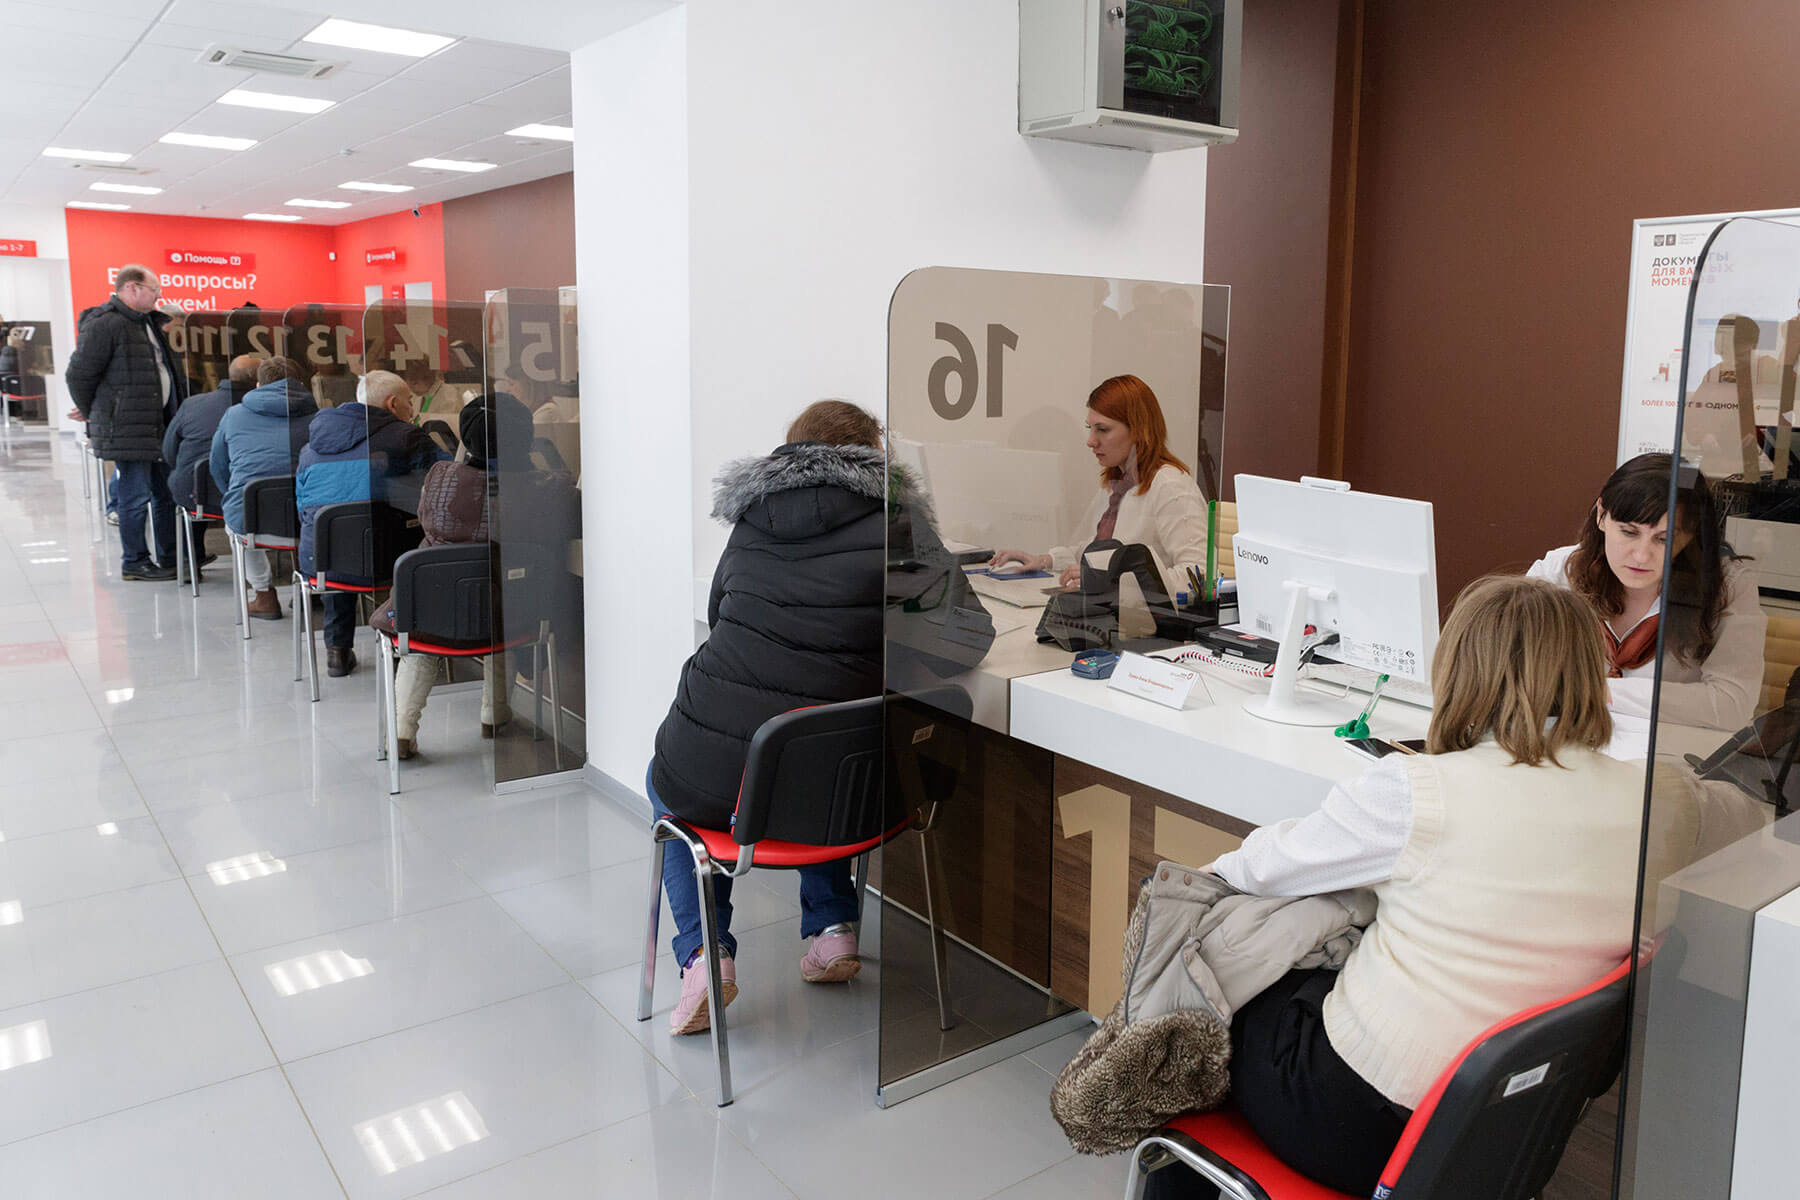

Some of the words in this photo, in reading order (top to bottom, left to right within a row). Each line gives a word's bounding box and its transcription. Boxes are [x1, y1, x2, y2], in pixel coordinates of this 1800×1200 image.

[184, 254, 228, 265] Помощь
[1651, 267, 1676, 277] ДЛЯ
[160, 274, 257, 291] вопросы?
[1237, 546, 1269, 566] Lenovo
